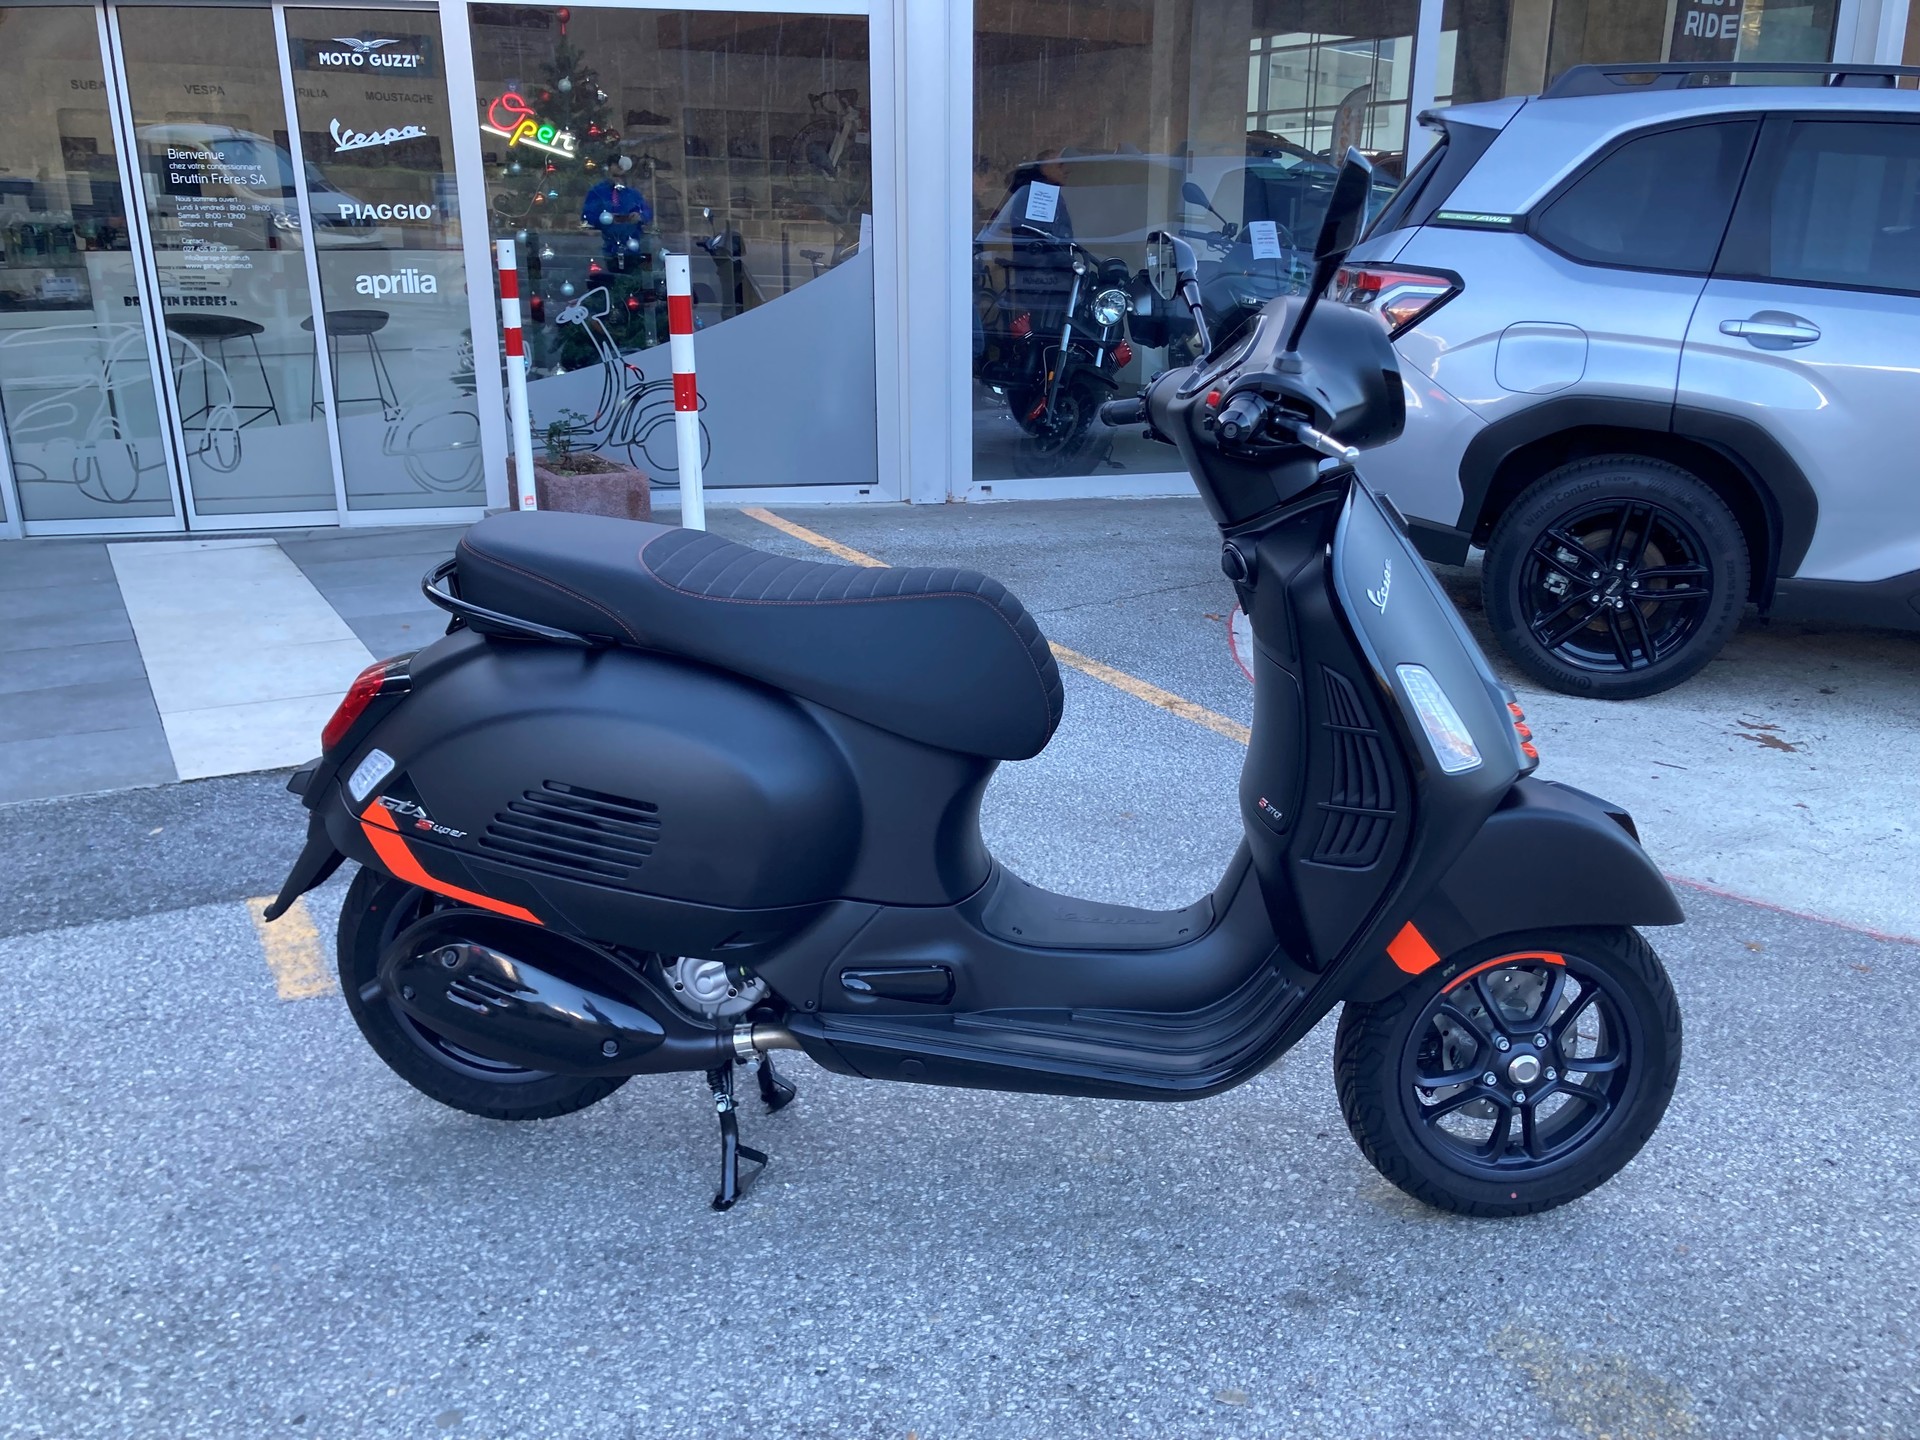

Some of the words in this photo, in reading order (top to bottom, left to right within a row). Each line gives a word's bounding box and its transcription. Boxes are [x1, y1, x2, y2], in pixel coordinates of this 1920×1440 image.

[1684, 10, 1739, 38] RIDE
[318, 52, 364, 66] MOTO
[370, 54, 417, 68] GUZZI
[70, 80, 106, 90] SUBA
[184, 84, 225, 96] VESPA
[364, 91, 434, 104] MOUSTACHE
[488, 92, 576, 150] Open
[330, 118, 426, 152] Vespa
[167, 149, 224, 160] Bienvenue
[171, 173, 208, 184] Bruttin
[211, 173, 247, 184] Frères
[250, 174, 267, 185] SA
[338, 204, 432, 220] PIAGGIO
[356, 269, 437, 299] aprilia
[182, 296, 227, 306] FRERES
[414, 818, 468, 838] Super
